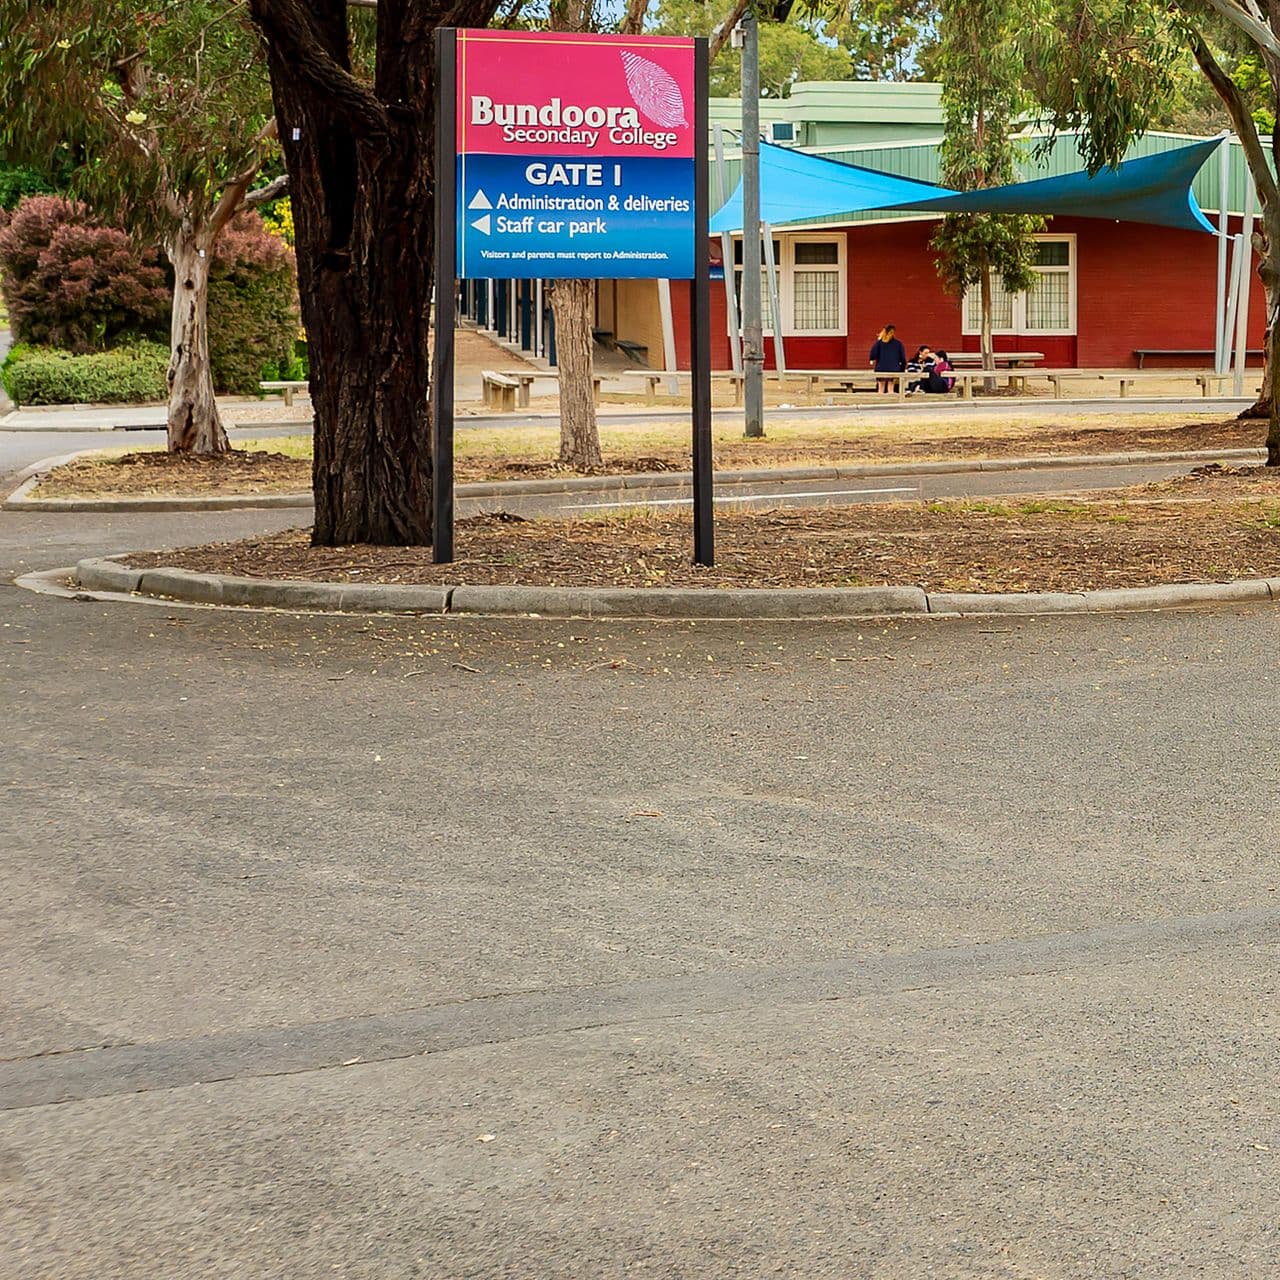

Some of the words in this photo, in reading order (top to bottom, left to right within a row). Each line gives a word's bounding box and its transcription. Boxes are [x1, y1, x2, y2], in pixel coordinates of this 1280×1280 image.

[471, 96, 639, 127] Bundoora
[503, 126, 598, 147] Secondary
[609, 128, 677, 149] College
[525, 162, 603, 186] GATE
[495, 192, 604, 211] Administration
[607, 194, 620, 211] &
[623, 194, 690, 212] deliveries
[496, 215, 535, 233] Staff
[537, 220, 565, 234] car
[568, 216, 607, 238] park
[480, 249, 511, 260] Visitors
[511, 250, 525, 260] and
[527, 251, 556, 261] parents
[556, 251, 576, 260] must
[577, 252, 602, 262] report
[603, 251, 612, 261] to
[612, 250, 669, 261] Administration.
